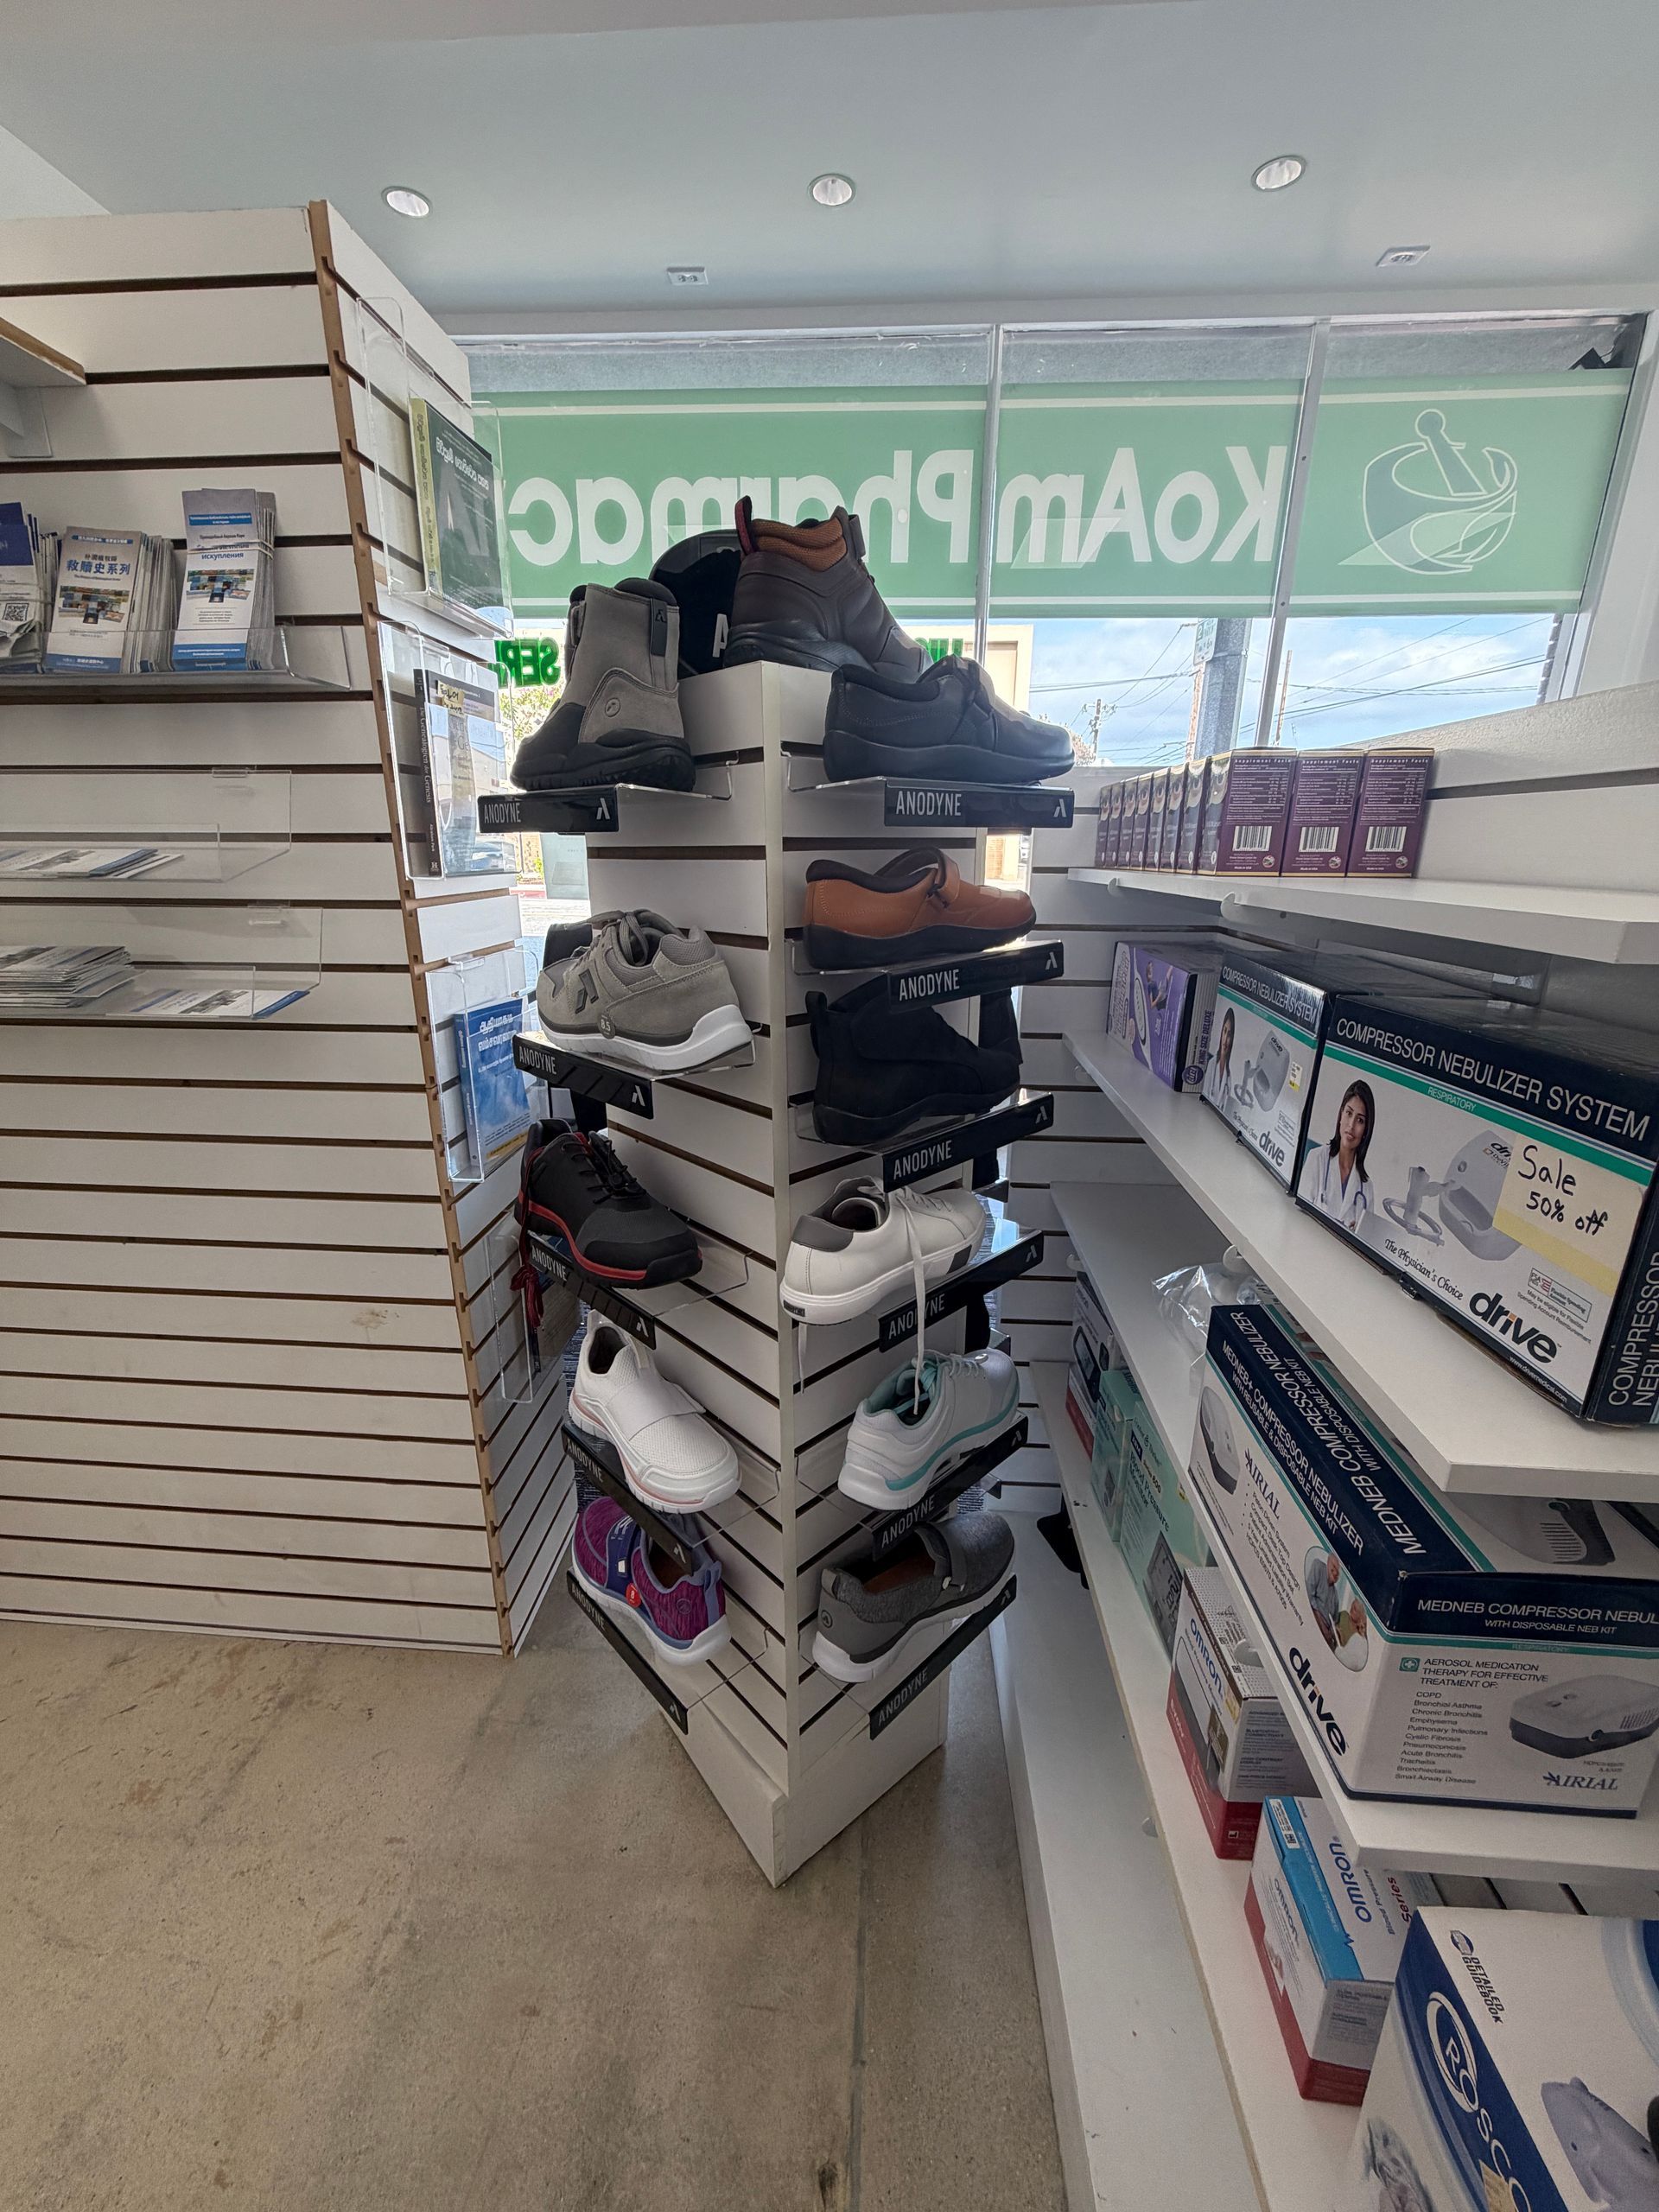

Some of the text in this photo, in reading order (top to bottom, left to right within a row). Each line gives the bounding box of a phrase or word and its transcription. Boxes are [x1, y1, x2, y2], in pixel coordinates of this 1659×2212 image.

[420, 718, 430, 764] Genealogien
[484, 803, 521, 823] ANODYNE
[896, 791, 962, 817] ANODYNE
[899, 969, 960, 1001] ANODYNE
[1222, 966, 1317, 1024] COMPRESSOR NEBULIZER SYSTEM
[518, 1046, 557, 1075] ANODYNE
[1337, 1018, 1649, 1141] COMPRESSOR NEBULIZER SYSTEM
[1427, 1087, 1477, 1112] RESPIRATORY
[893, 1140, 952, 1180] ANODYNE
[1259, 1130, 1285, 1167] drive
[1517, 1145, 1577, 1197] Sale
[1526, 1190, 1609, 1236] 50% off
[531, 1249, 567, 1281] ANODYNE
[1384, 1238, 1464, 1300] The Physician's Choice
[888, 1293, 945, 1340] ANOYNE
[1469, 1292, 1557, 1363] drive
[1230, 1312, 1287, 1371] NEBULIZER
[1282, 1357, 1300, 1370] KIT
[1294, 1370, 1314, 1389] NEB
[1509, 1356, 1567, 1403] www.drivemedical.com
[1274, 1370, 1361, 1472] COMPRESSOR
[1308, 1388, 1359, 1445] DISPOSABLE
[567, 1438, 603, 1483] ANODYNE
[1222, 1340, 1253, 1389] MEDNEB+
[1253, 1388, 1310, 1469] COMPRESSOR
[1308, 1467, 1363, 1555] NEBULIZER
[1232, 1374, 1243, 1395] WITH
[1241, 1389, 1268, 1433] REUSABLE
[1273, 1436, 1313, 1496] DISPOSABLE
[1310, 1492, 1325, 1516] NEB
[1324, 1514, 1338, 1535] KIT
[1355, 1445, 1382, 1471] WITH
[1129, 1452, 1146, 1485] Blood
[1144, 1482, 1169, 1532] Pressure
[1247, 1457, 1281, 1520] AIRIAL
[880, 1494, 935, 1549] ANODYNE
[1351, 1477, 1427, 1555] MEDNEB
[570, 1583, 606, 1630] ANODYNE
[1417, 1599, 1484, 1616] MEDNEB
[1489, 1602, 1602, 1622] COMPRESSOR
[1484, 1619, 1618, 1635] WITH DISPOSABLE NEB KIT
[1190, 1618, 1224, 1693] OMRON
[1424, 1658, 1540, 1671] AEROSOL MEDICATION
[1511, 1643, 1570, 1654] RESPIRATORY
[878, 1668, 928, 1726] ANODYNE
[1421, 1677, 1479, 1688] TREATMENT
[1422, 1668, 1469, 1677] THERAPY
[1493, 1672, 1549, 1682] EFFECTIVE
[1288, 1647, 1346, 1757] drive
[1410, 1716, 1458, 1726] Emphysema
[1412, 1707, 1443, 1716] Chronic
[1405, 1733, 1429, 1742] Cystic
[1408, 1725, 1448, 1733] Pulmonary
[1425, 1751, 1464, 1759] Bronchitis
[1554, 1773, 1618, 1791] AIRIAL
[1328, 1842, 1372, 1923] OMRON
[1386, 1877, 1413, 1923] Series
[1462, 1956, 1503, 2024] GUIDEBOOK
[1471, 1956, 1505, 2012] DETAILED
